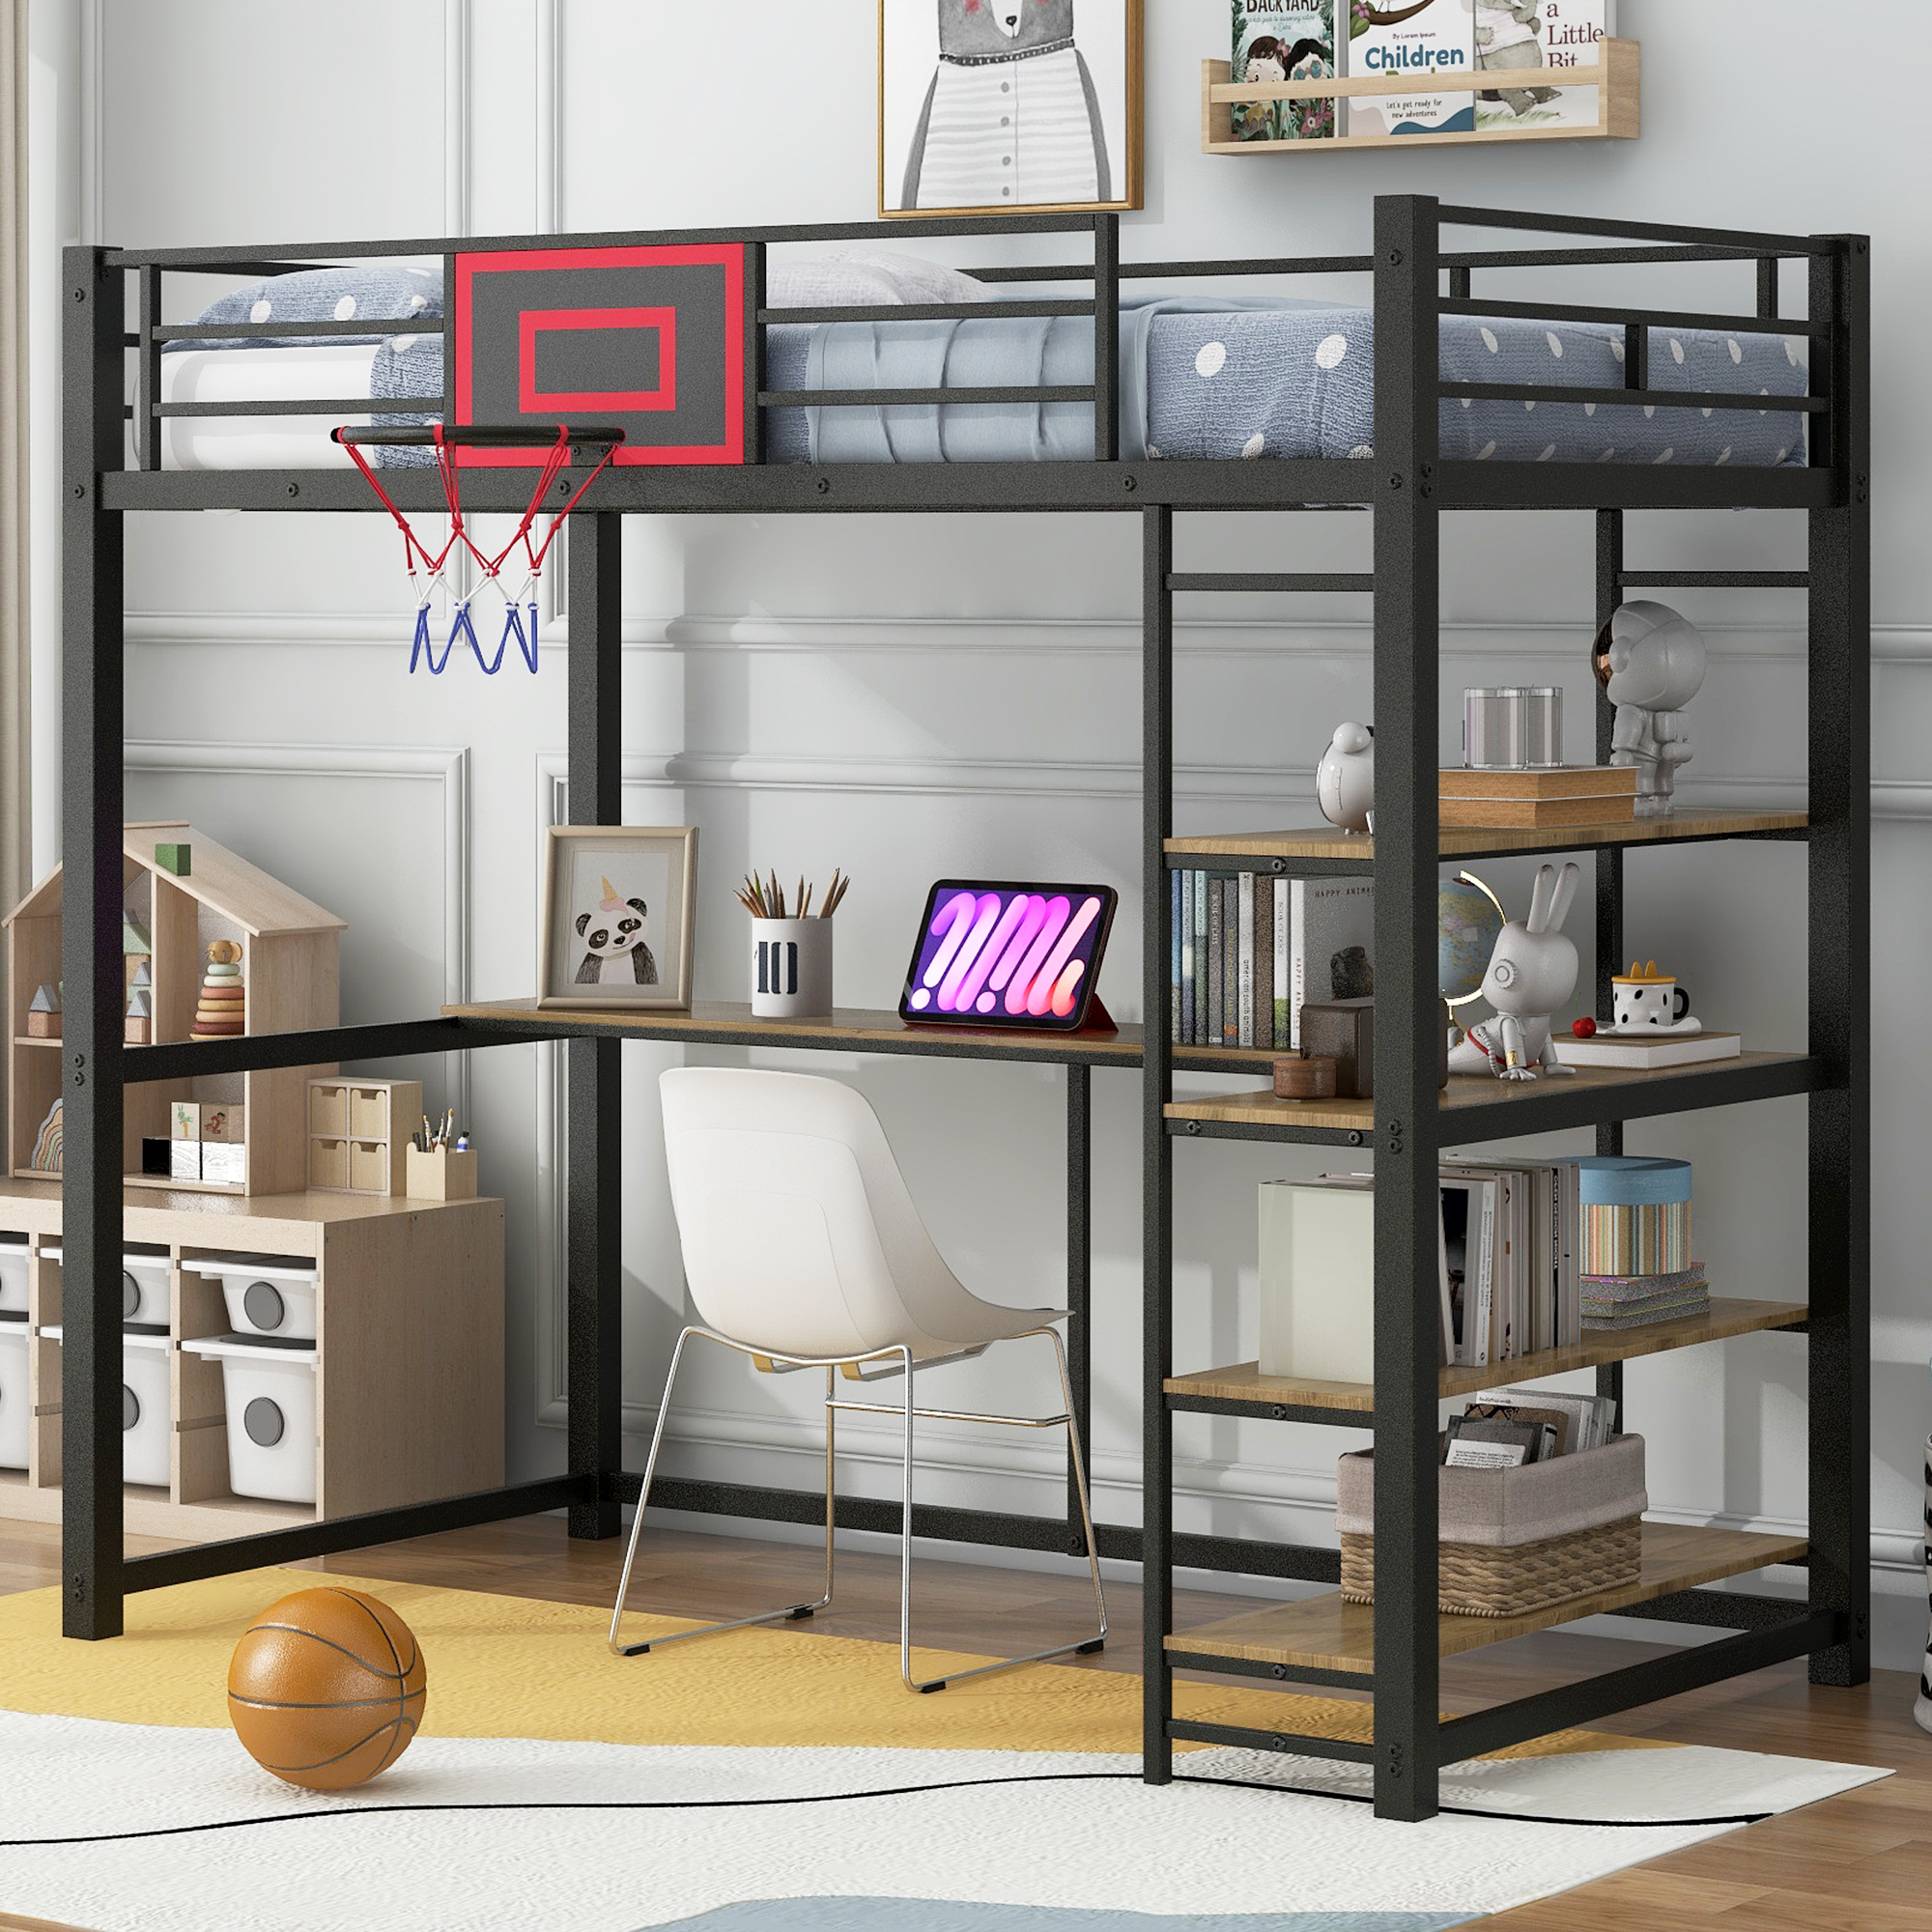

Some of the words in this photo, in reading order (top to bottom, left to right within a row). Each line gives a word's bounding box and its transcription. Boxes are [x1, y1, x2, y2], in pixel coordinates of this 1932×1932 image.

[1247, 0, 1320, 13] BACKYARD
[1547, 4, 1559, 17] a
[1547, 22, 1604, 45] Little
[1365, 44, 1464, 70] Children
[1547, 52, 1577, 68] Bit
[1403, 101, 1412, 110] get
[1414, 99, 1431, 109] ready
